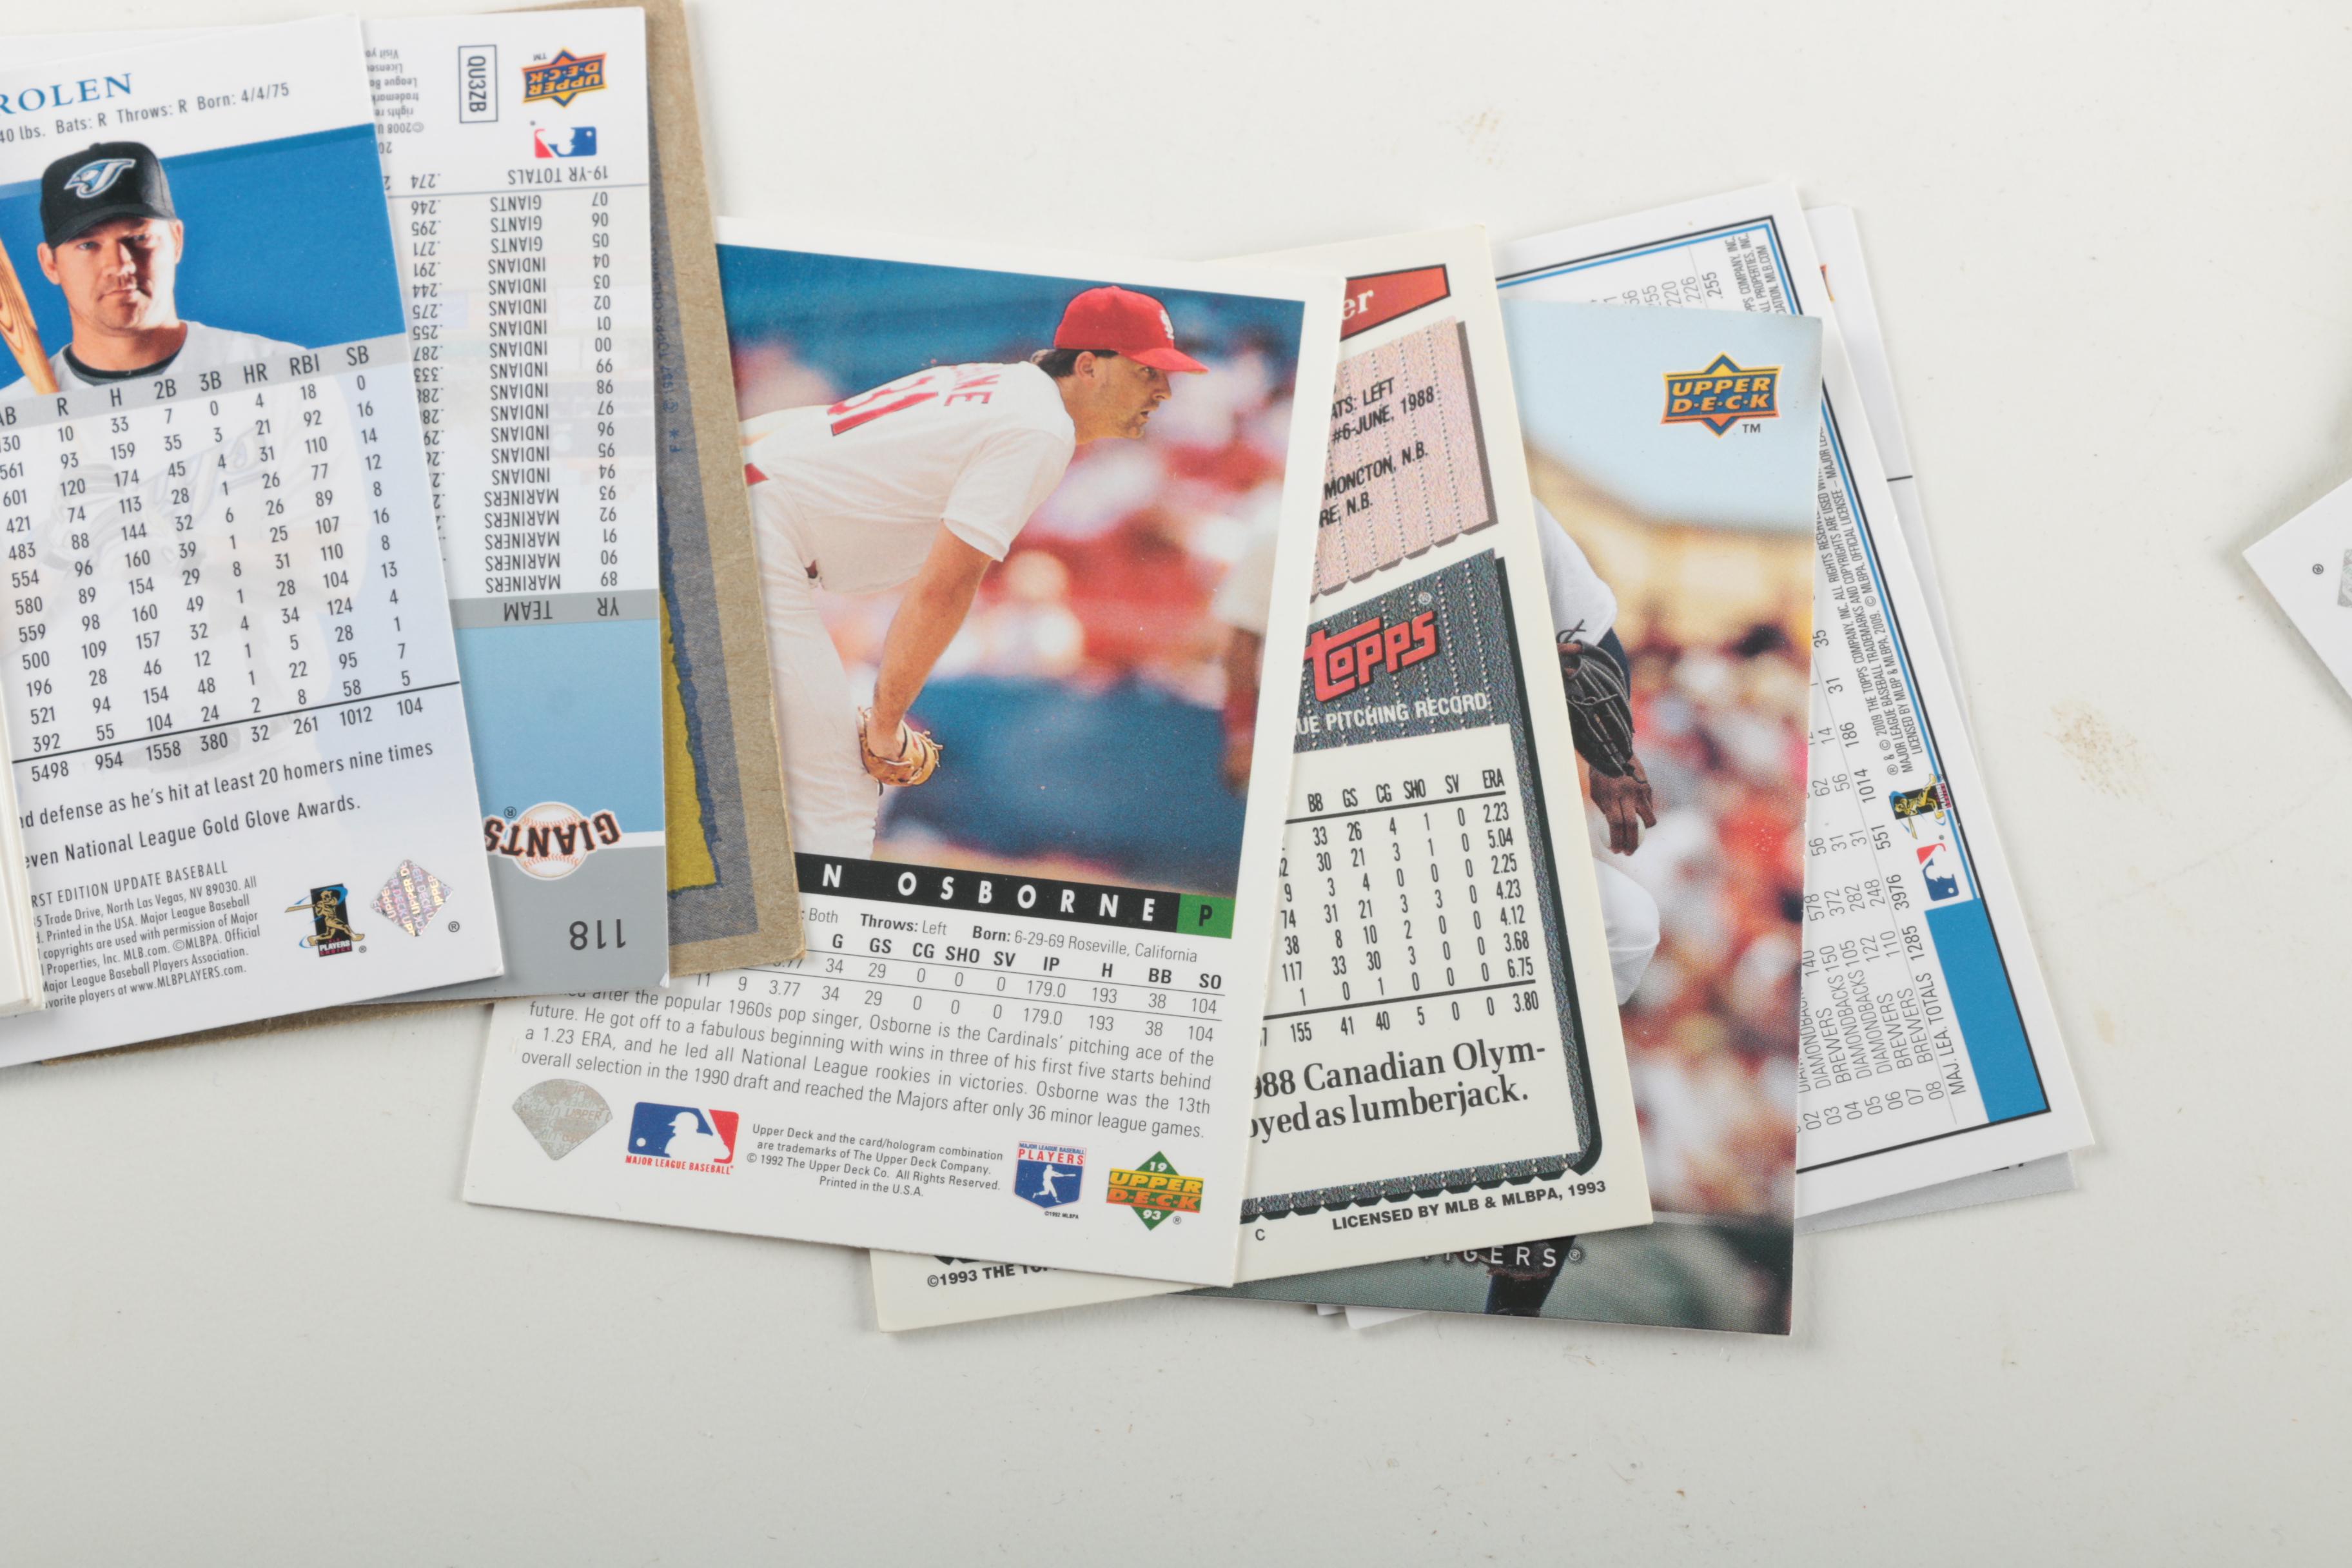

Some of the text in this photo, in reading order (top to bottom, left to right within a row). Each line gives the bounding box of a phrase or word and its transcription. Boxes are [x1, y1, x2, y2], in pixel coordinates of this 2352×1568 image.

[467, 55, 487, 112] QU3ZB
[529, 74, 600, 95] UPPER
[19, 83, 289, 140] lbs. Bats: R Throws: R Born: 4/4/75
[411, 166, 608, 189] 19-YR TOTALS .274
[411, 191, 608, 215] 07 GIANTS .246
[414, 233, 609, 257] 05 GIANTS .271
[1702, 272, 1723, 299] .255
[57, 346, 369, 417] R H 2B 3B HR RBI SB
[1363, 377, 1395, 406] LEFT
[1672, 378, 1770, 396] UPPER
[1400, 386, 1435, 415] 1988
[1743, 424, 1760, 433] TM
[492, 464, 616, 485] 94 INDIANS
[1324, 442, 1428, 500] MONCTON, N.B.
[485, 528, 617, 550] 91 MARINERS
[504, 596, 619, 622] YR TEAM
[1326, 692, 1488, 731] PITCHING RECORD
[32, 697, 423, 782] 5498 954 1558 380 32 261 1012 104
[40, 743, 433, 825] defense as he's hit at least 20 homers nine times
[1307, 769, 1504, 812] BB GS CG SHO SV ERA
[65, 794, 360, 861] National League Gold Glove Awards.
[484, 812, 621, 857] GIANTS
[1198, 903, 1213, 927] P
[1839, 722, 1966, 1095] MAJ. LEA. TOTALS 1285 3976 551 1014 186
[569, 919, 626, 950] 118
[809, 908, 1197, 963] Both Throws: Left Born: 6-29-69 Roseville, California
[832, 934, 1222, 989] G GS CG SHO SV IP H BB SO
[1848, 970, 1903, 1110] 06 DIAMONDBACKS
[1897, 988, 1944, 1100] 08 BREWERS
[1304, 1051, 1446, 1091] Canadian
[1453, 1039, 1545, 1074] Olym-
[522, 1052, 1204, 1138] overall selection in the 1990 draft and reached the Majors after only 36 minor league games.
[1316, 1075, 1528, 1128] as lumberjack.
[753, 1124, 1003, 1161] Upper Deck and the card/hologram combination
[1018, 1148, 1084, 1165] PLAYERS
[625, 1155, 731, 1175] MAJOR LEAGUE BASEBALL
[1150, 1161, 1168, 1171] 19
[1110, 1172, 1202, 1194] UPPER
[1142, 1210, 1161, 1220] 93
[1333, 1181, 1606, 1230] LICENSED BY MLB & MLBPA, 1993
[983, 1263, 1015, 1279] THE
